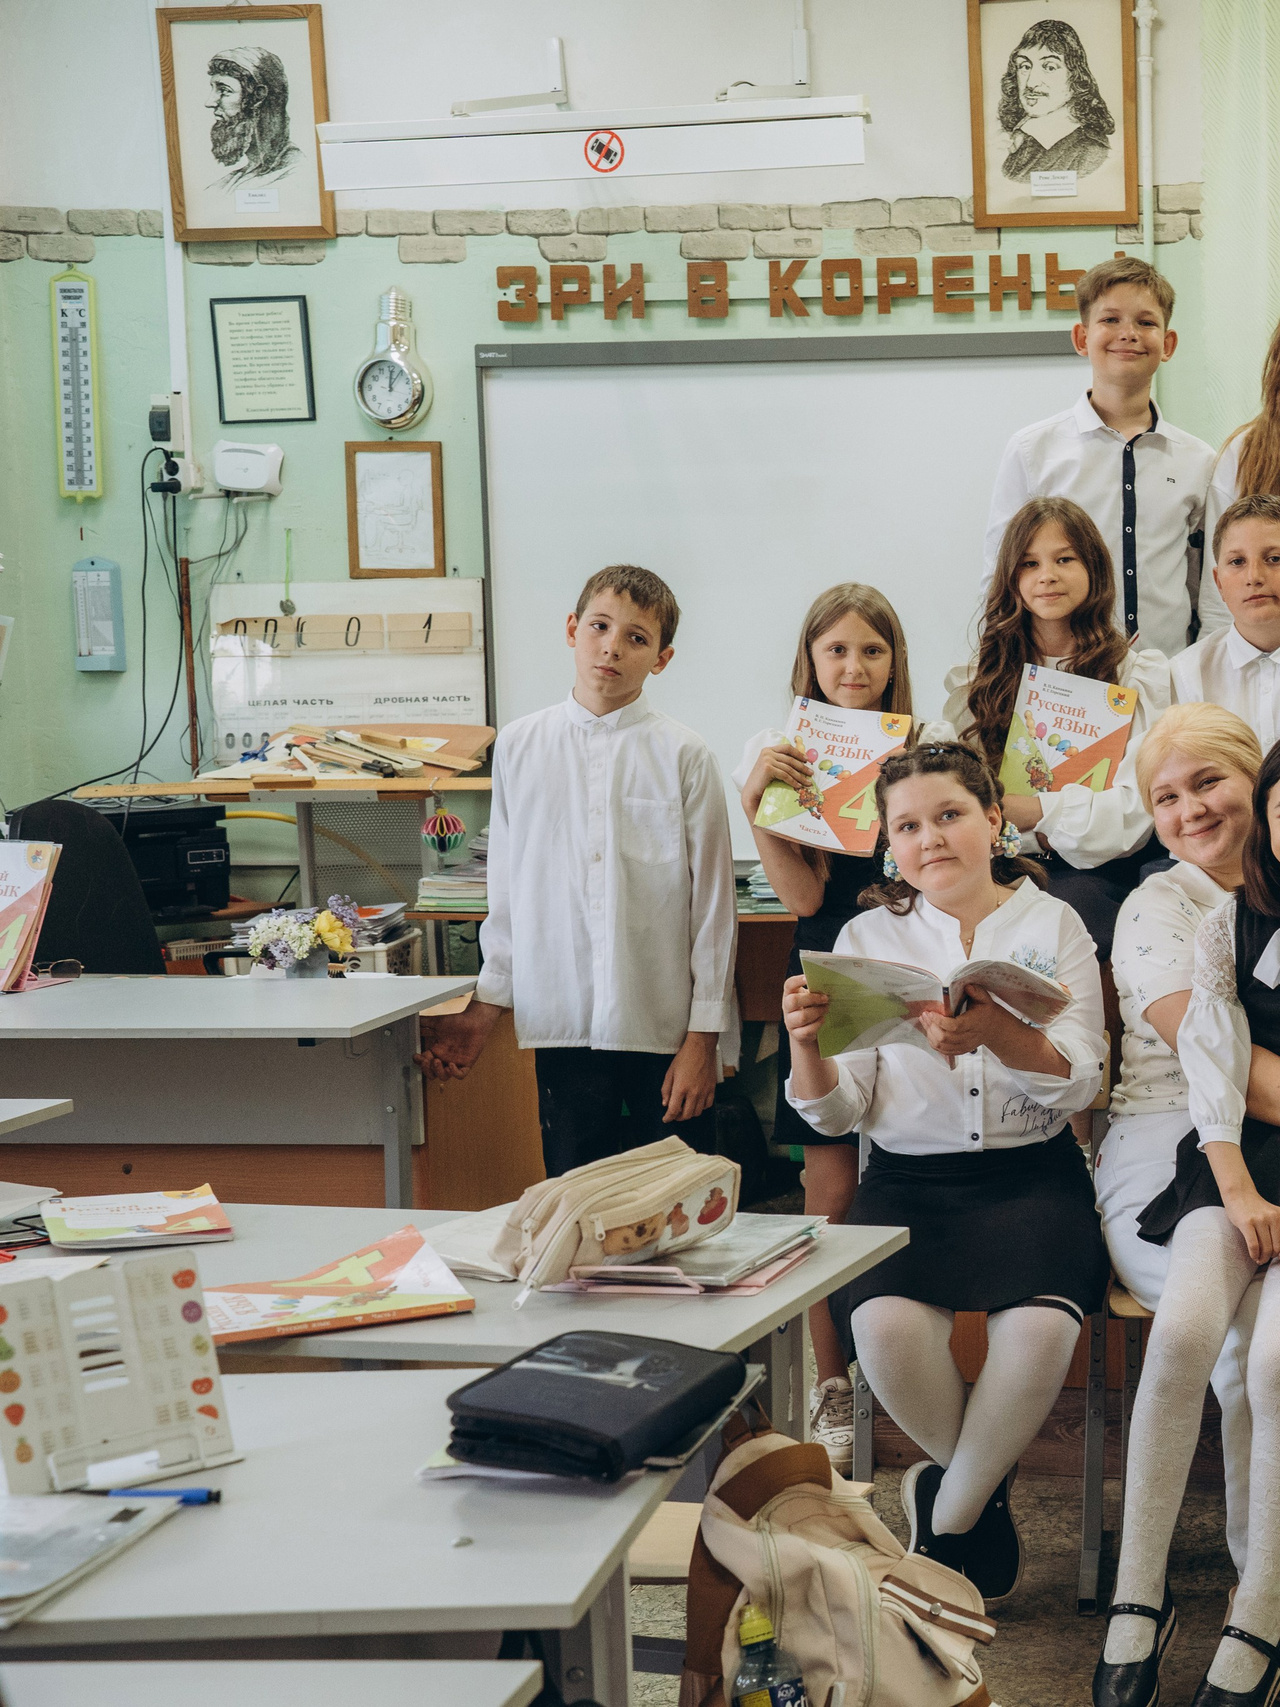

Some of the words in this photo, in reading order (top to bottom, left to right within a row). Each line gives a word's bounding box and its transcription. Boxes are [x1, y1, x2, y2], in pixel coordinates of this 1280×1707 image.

[496, 262, 645, 322] ЗРИ
[687, 260, 729, 318] В
[768, 252, 1081, 317] КОРЕНЬ
[60, 308, 68, 318] K
[423, 613, 433, 643] 1
[248, 699, 287, 707] ЦЕЛАЯ
[293, 698, 334, 706] ЧАСТЬ
[373, 696, 429, 705] ДРОБНАЯ
[432, 695, 471, 703] ЧАСТЬ
[1026, 690, 1087, 718] Русский
[796, 718, 860, 745] Русский
[838, 779, 879, 831] 4
[271, 1249, 385, 1288] 4
[276, 1322, 309, 1334] Русский
